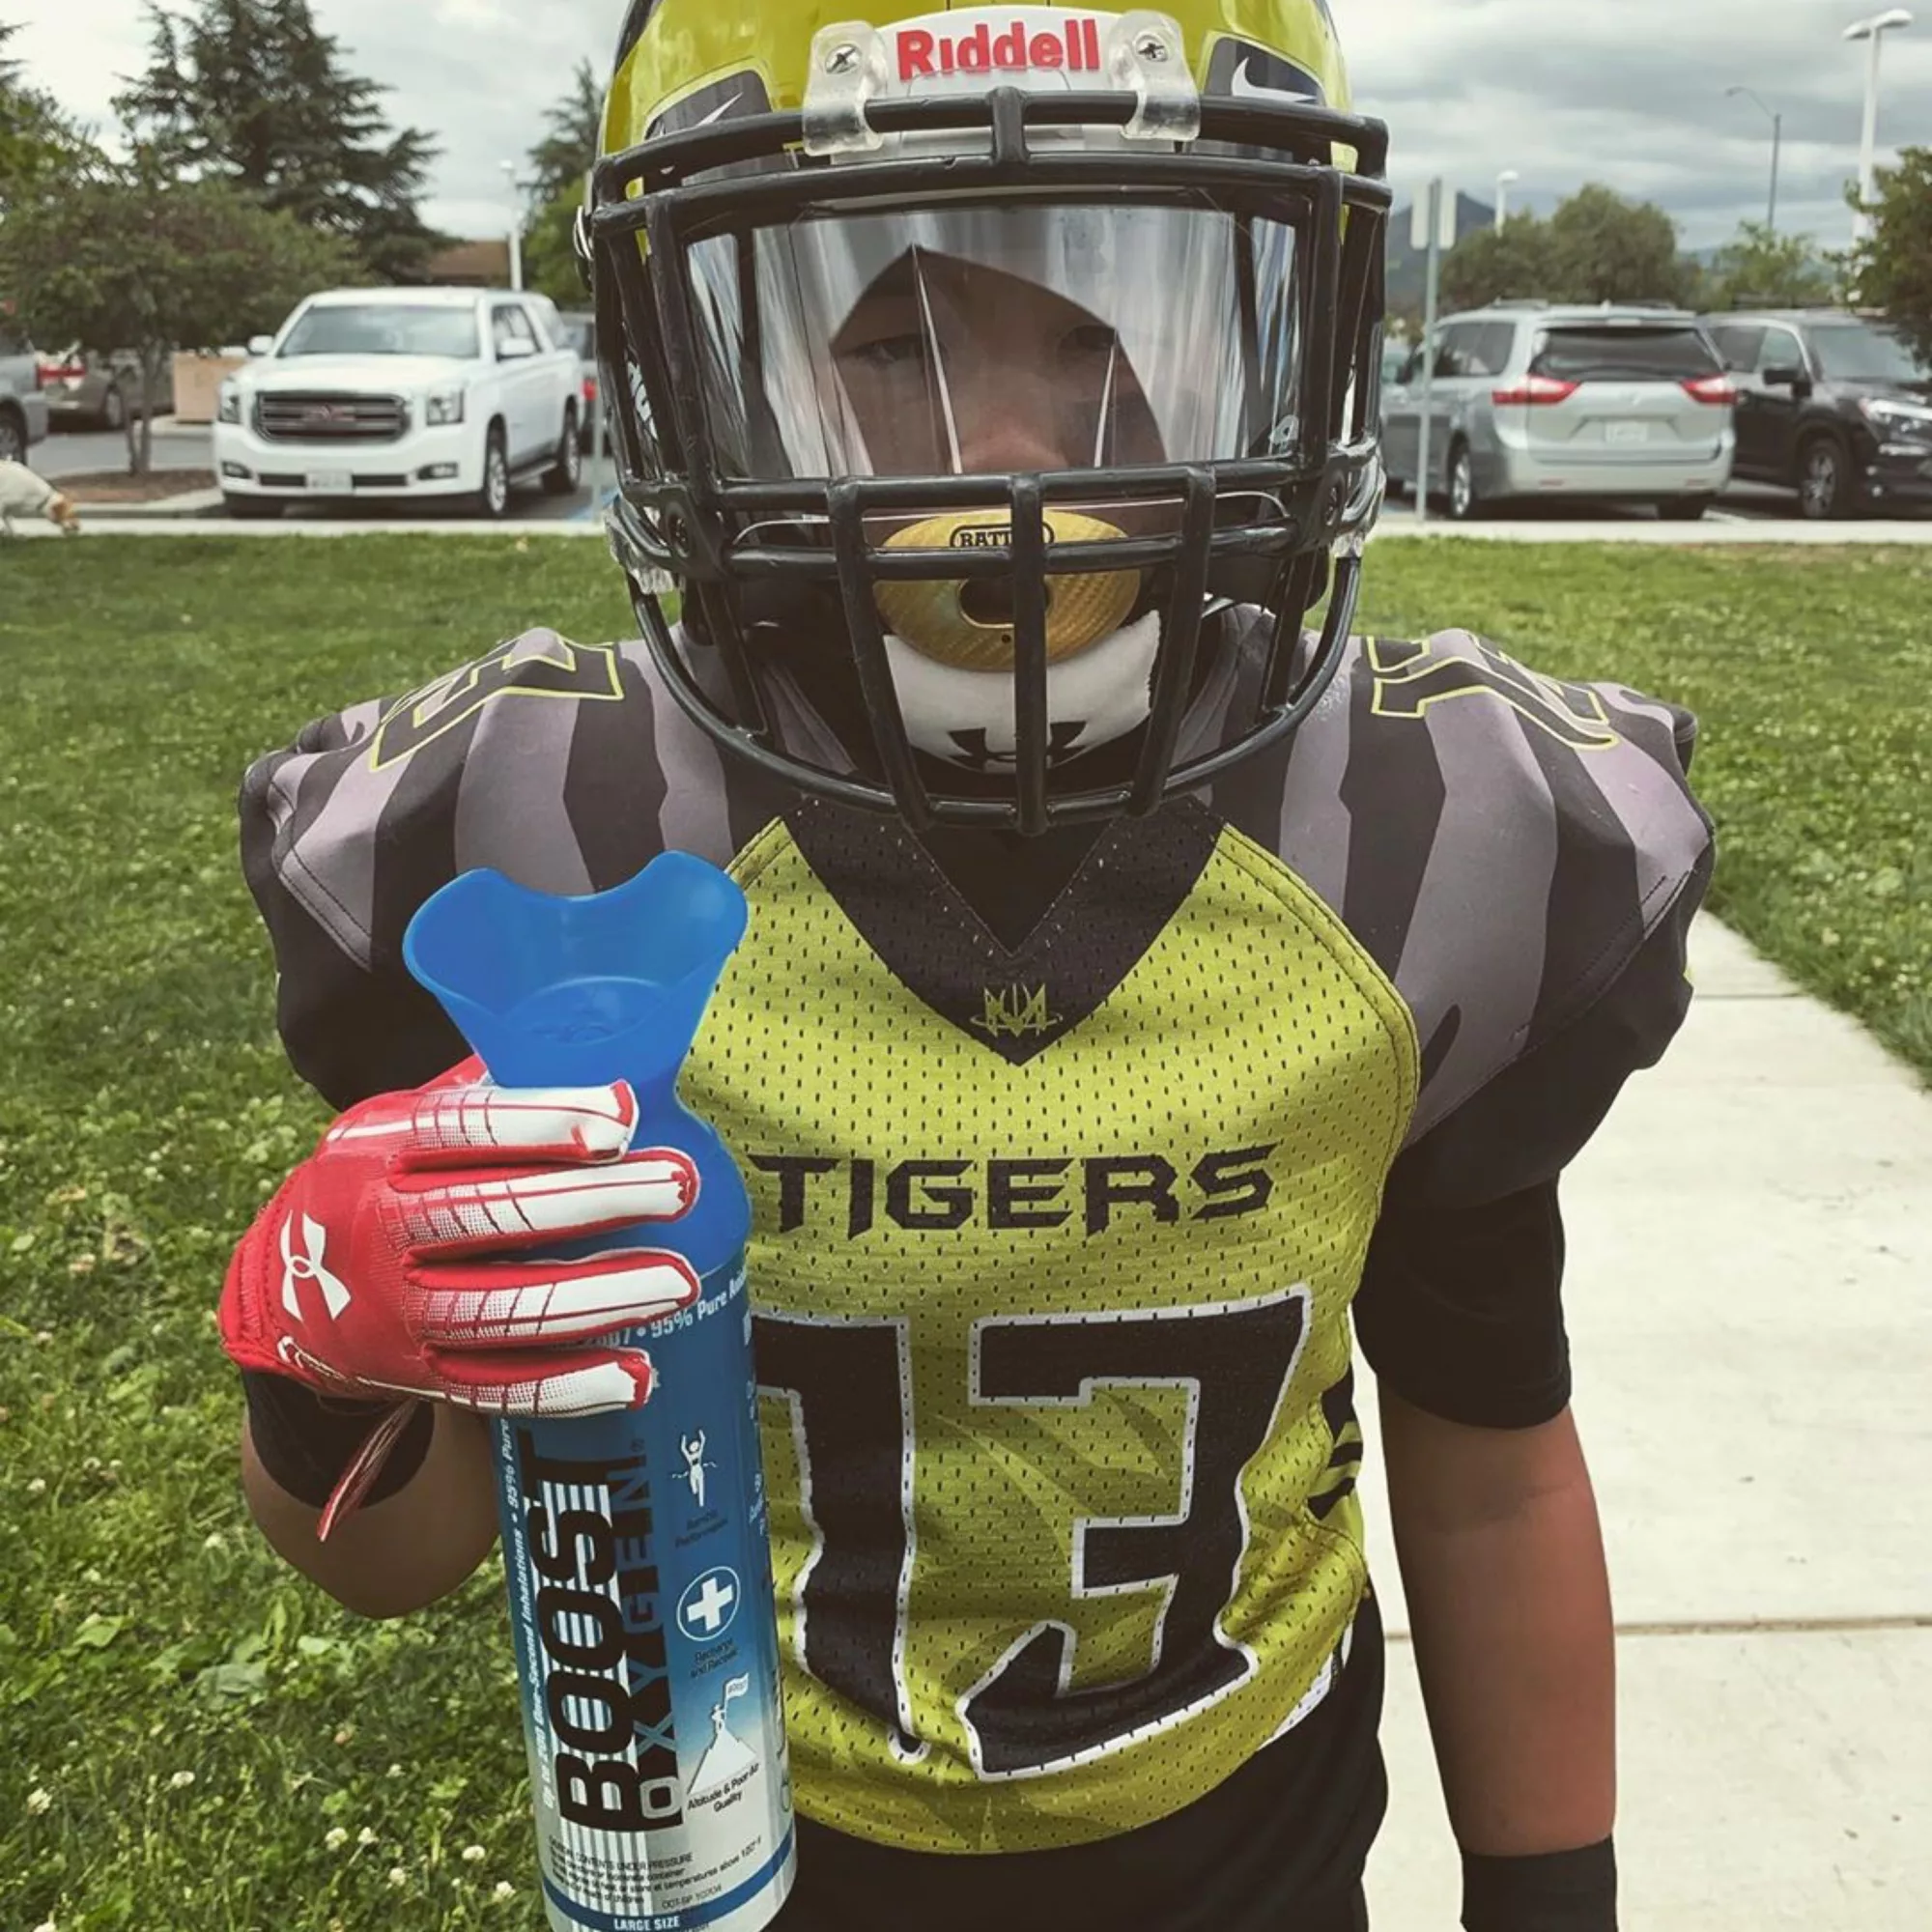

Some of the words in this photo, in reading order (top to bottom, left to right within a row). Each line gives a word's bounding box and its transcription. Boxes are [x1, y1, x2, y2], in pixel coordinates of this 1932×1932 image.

[896, 19, 1099, 81] Riddell
[746, 1142, 1283, 1240] TIGERS
[651, 1309, 694, 1338] 95%
[697, 1292, 727, 1321] Pure
[499, 1418, 514, 1461] Pure
[504, 1465, 520, 1509] 95%
[750, 1283, 1312, 1782] 13
[513, 1528, 532, 1623] Inhalations
[517, 1427, 640, 1831] BOOST
[607, 1467, 683, 1819] OXYGEN
[688, 1789, 723, 1810] Altitude
[713, 1790, 743, 1812] Quality
[613, 1918, 651, 1931] LARGE
[654, 1916, 681, 1930] SIZE
